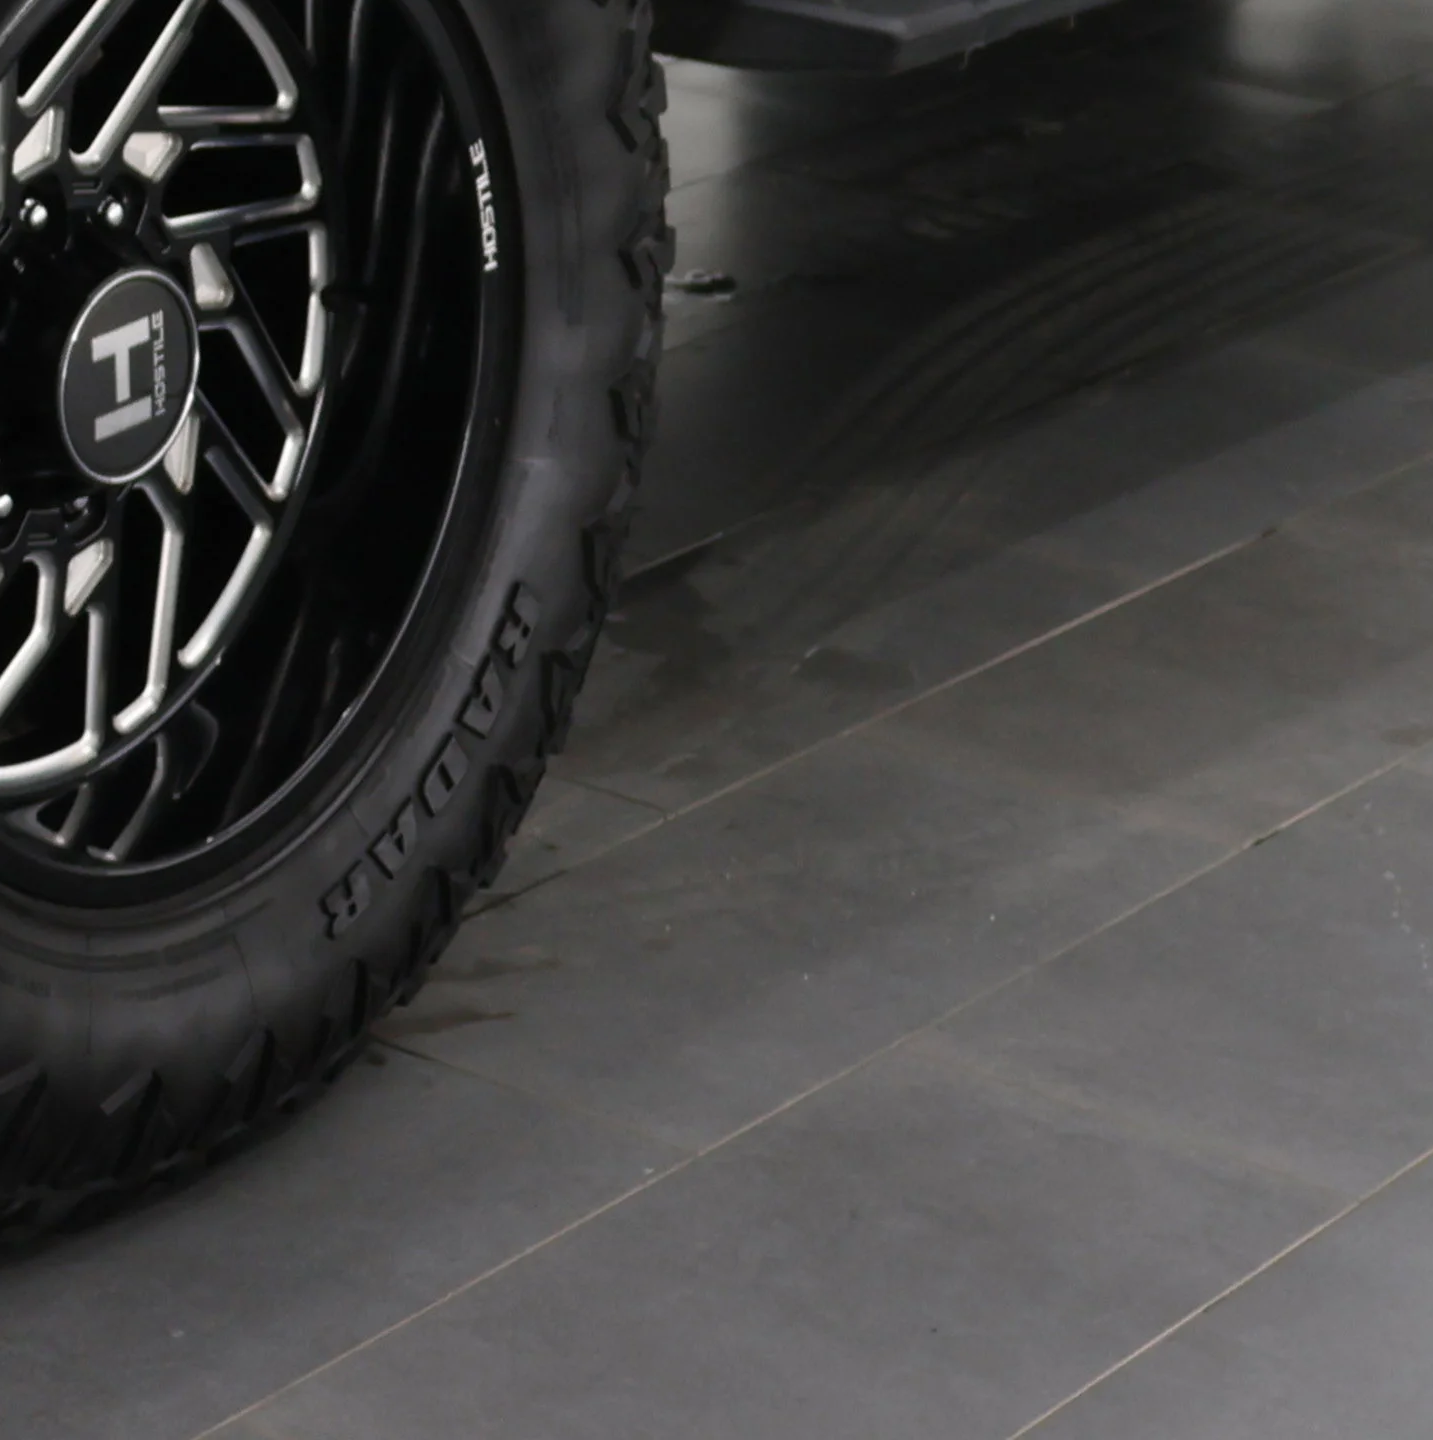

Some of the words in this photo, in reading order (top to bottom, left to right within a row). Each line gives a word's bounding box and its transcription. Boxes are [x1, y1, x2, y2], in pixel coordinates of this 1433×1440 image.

[468, 137, 500, 274] HOSTILE
[150, 308, 168, 417] HOSTILE
[318, 579, 541, 941] RADAR
